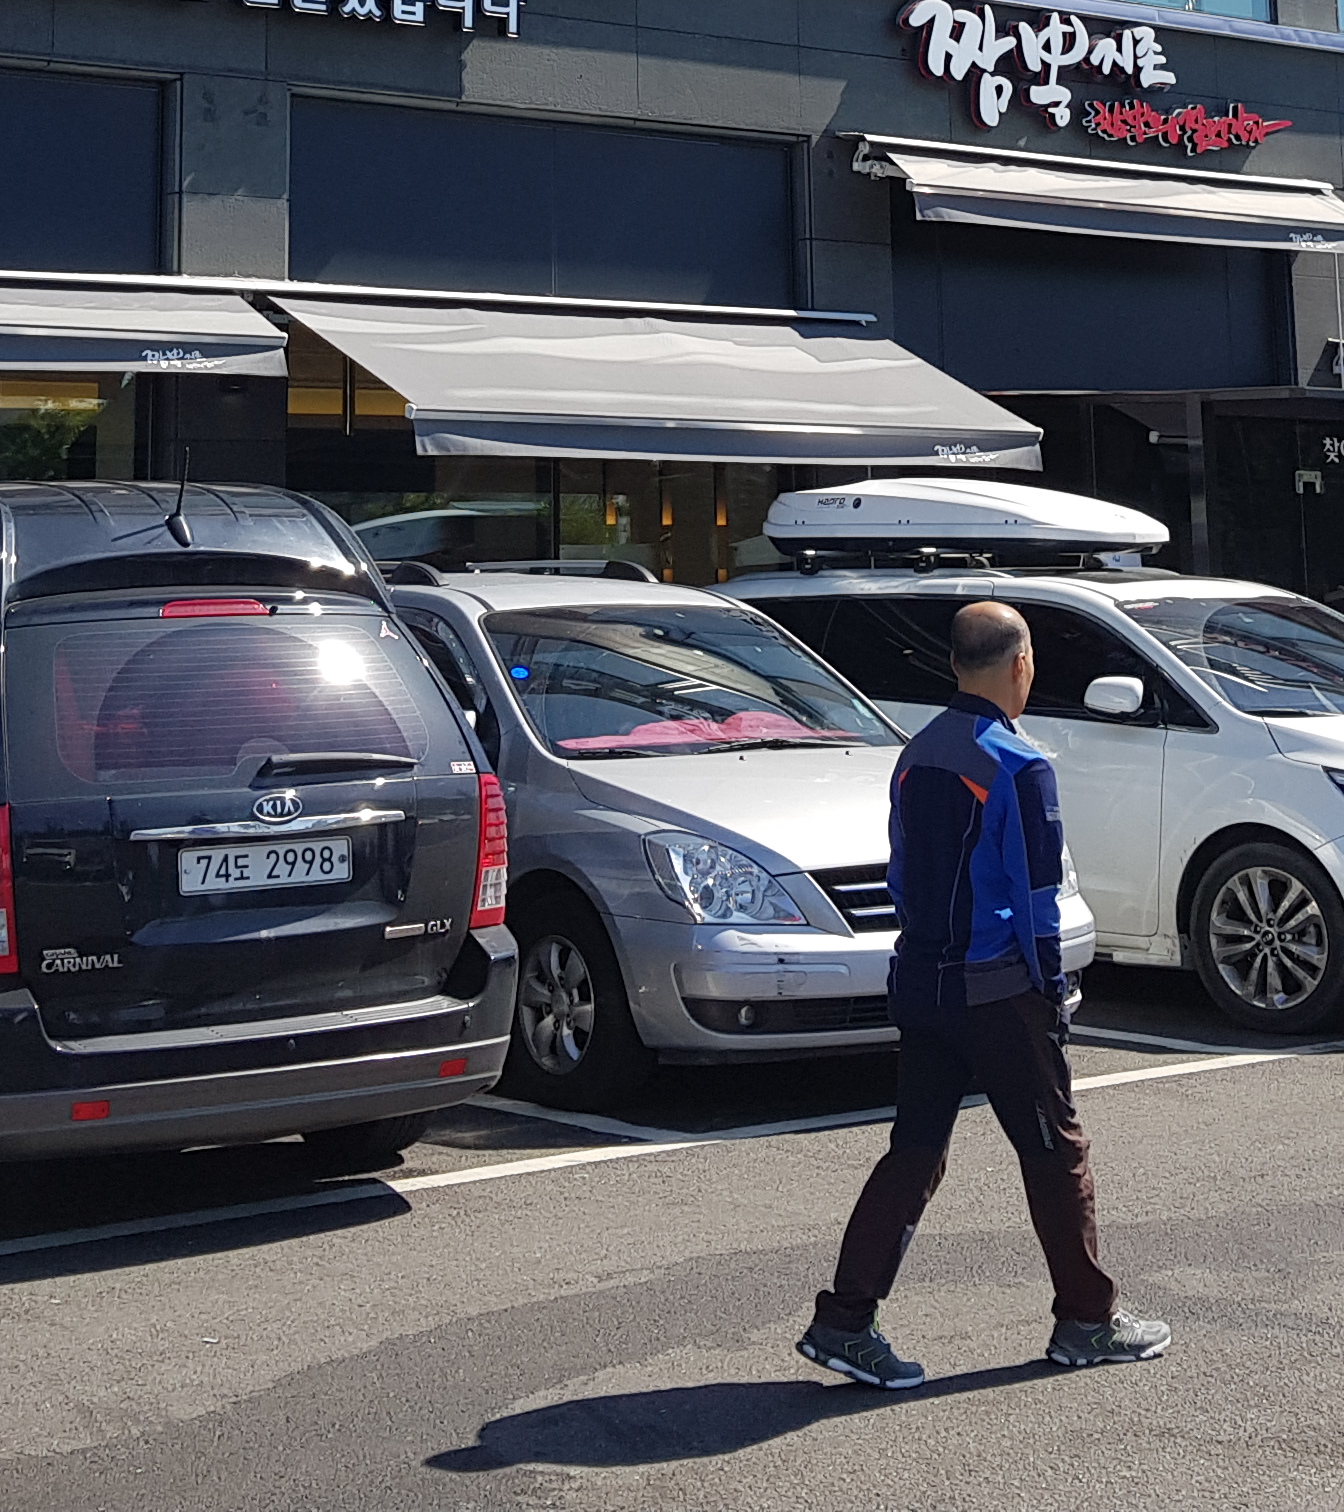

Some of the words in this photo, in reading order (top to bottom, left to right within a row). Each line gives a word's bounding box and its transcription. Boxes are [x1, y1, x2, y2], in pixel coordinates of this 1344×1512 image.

[262, 800, 296, 816] KIA
[196, 854, 251, 885] 74도
[266, 846, 334, 879] 2998
[427, 918, 452, 934] GLX
[40, 953, 124, 973] CARNIVAL
